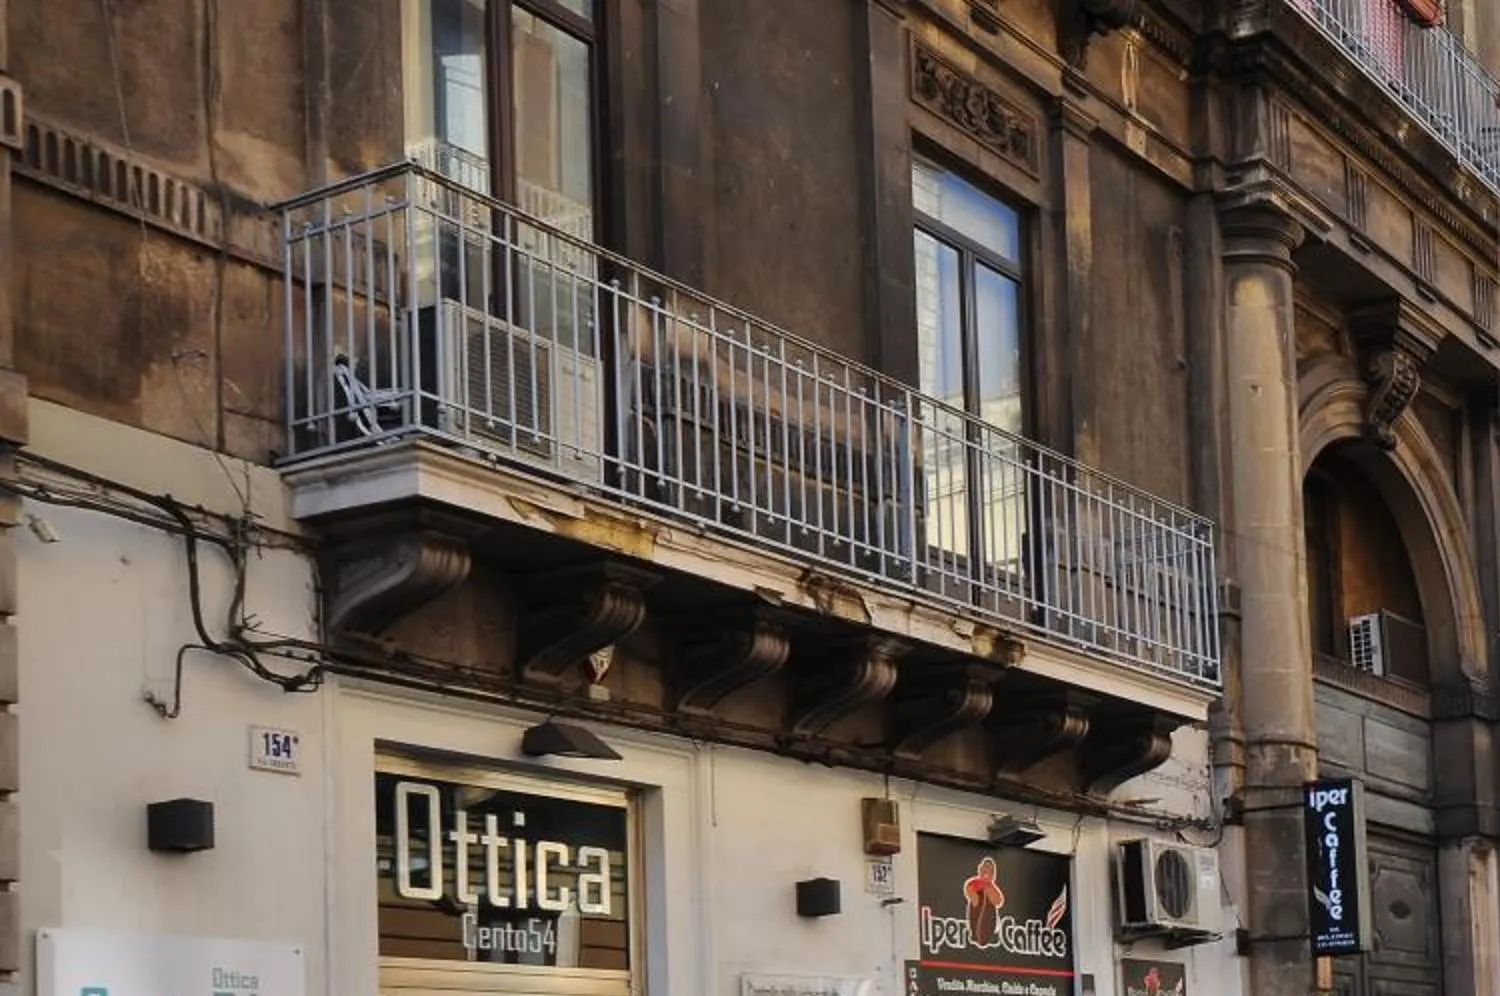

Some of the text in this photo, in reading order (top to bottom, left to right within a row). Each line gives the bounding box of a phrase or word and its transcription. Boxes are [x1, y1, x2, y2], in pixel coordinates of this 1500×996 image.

[396, 781, 611, 915] Ottica
[462, 913, 556, 954] Cento54
[921, 906, 968, 954] Iper
[212, 967, 259, 989] Ottica
